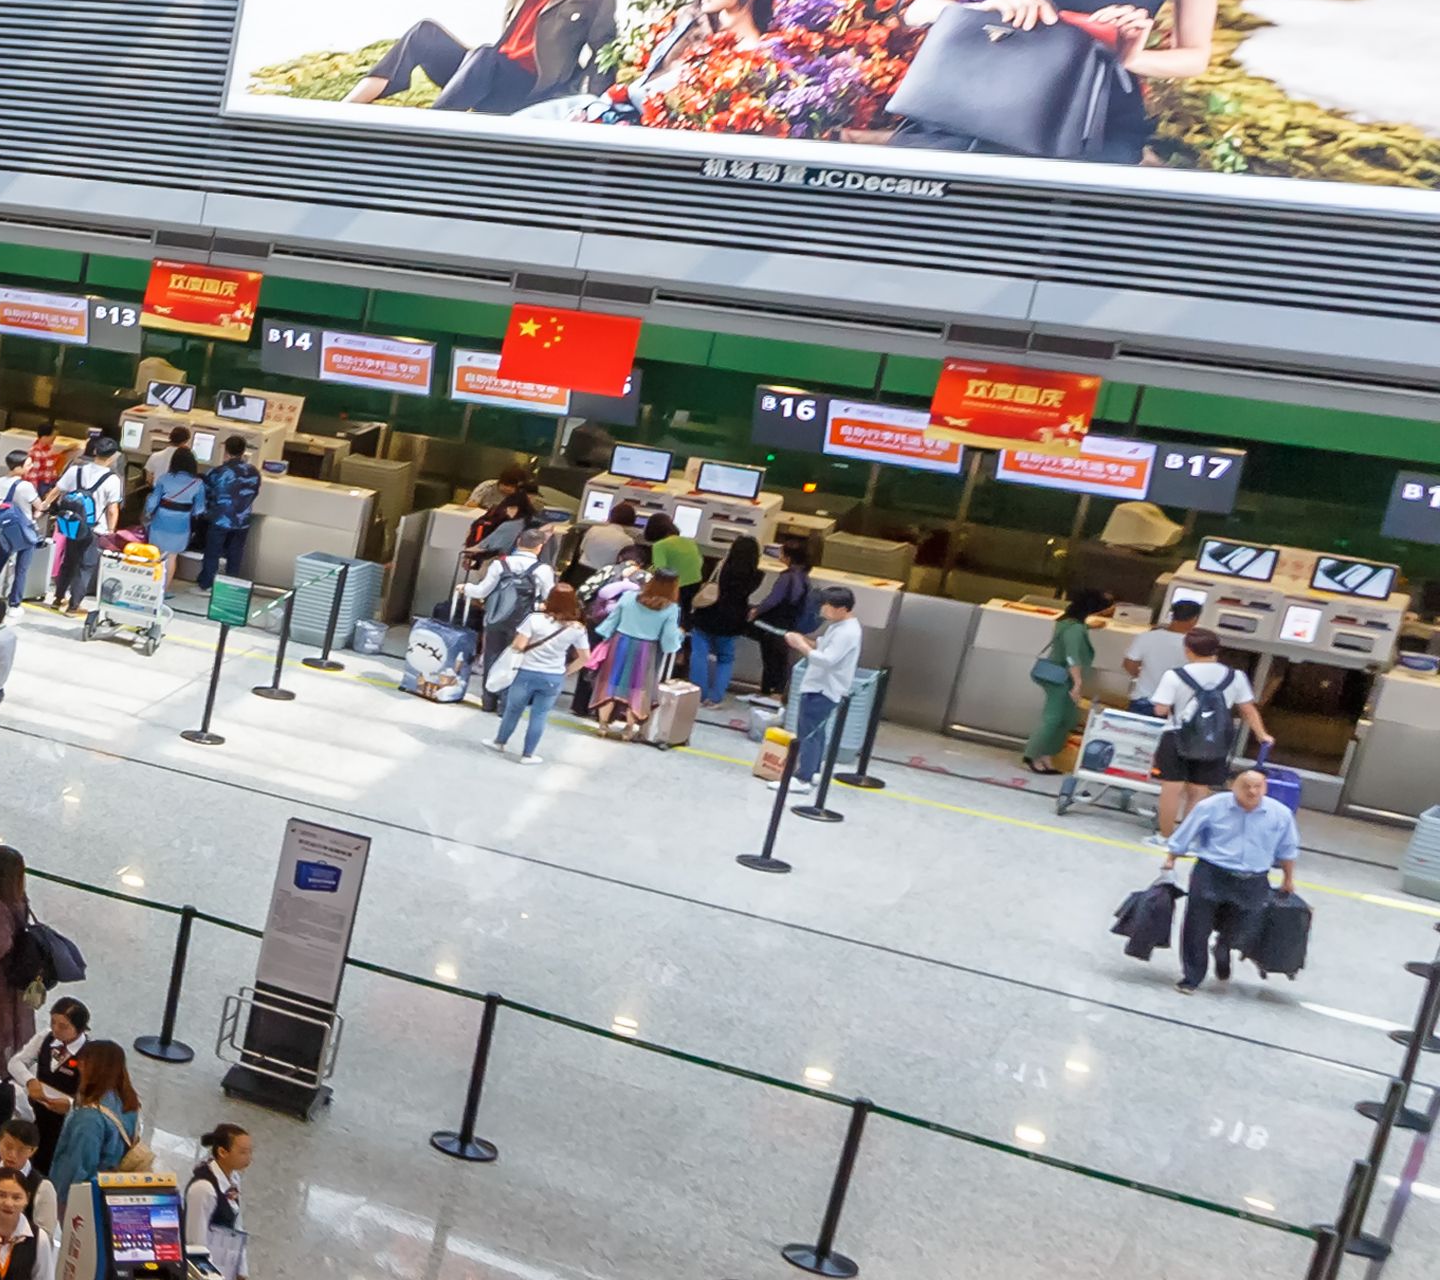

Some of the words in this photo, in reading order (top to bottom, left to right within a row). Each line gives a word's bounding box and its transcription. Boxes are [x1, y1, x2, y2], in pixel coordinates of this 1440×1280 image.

[703, 158, 808, 185] 机场动量
[808, 168, 947, 198] JCDecaux
[169, 272, 240, 298] 欢度国庆
[95, 305, 136, 327] B13
[268, 328, 313, 352] B14
[963, 378, 1067, 409] 欢度国庆
[761, 395, 816, 421] B16
[1164, 453, 1234, 479] B17
